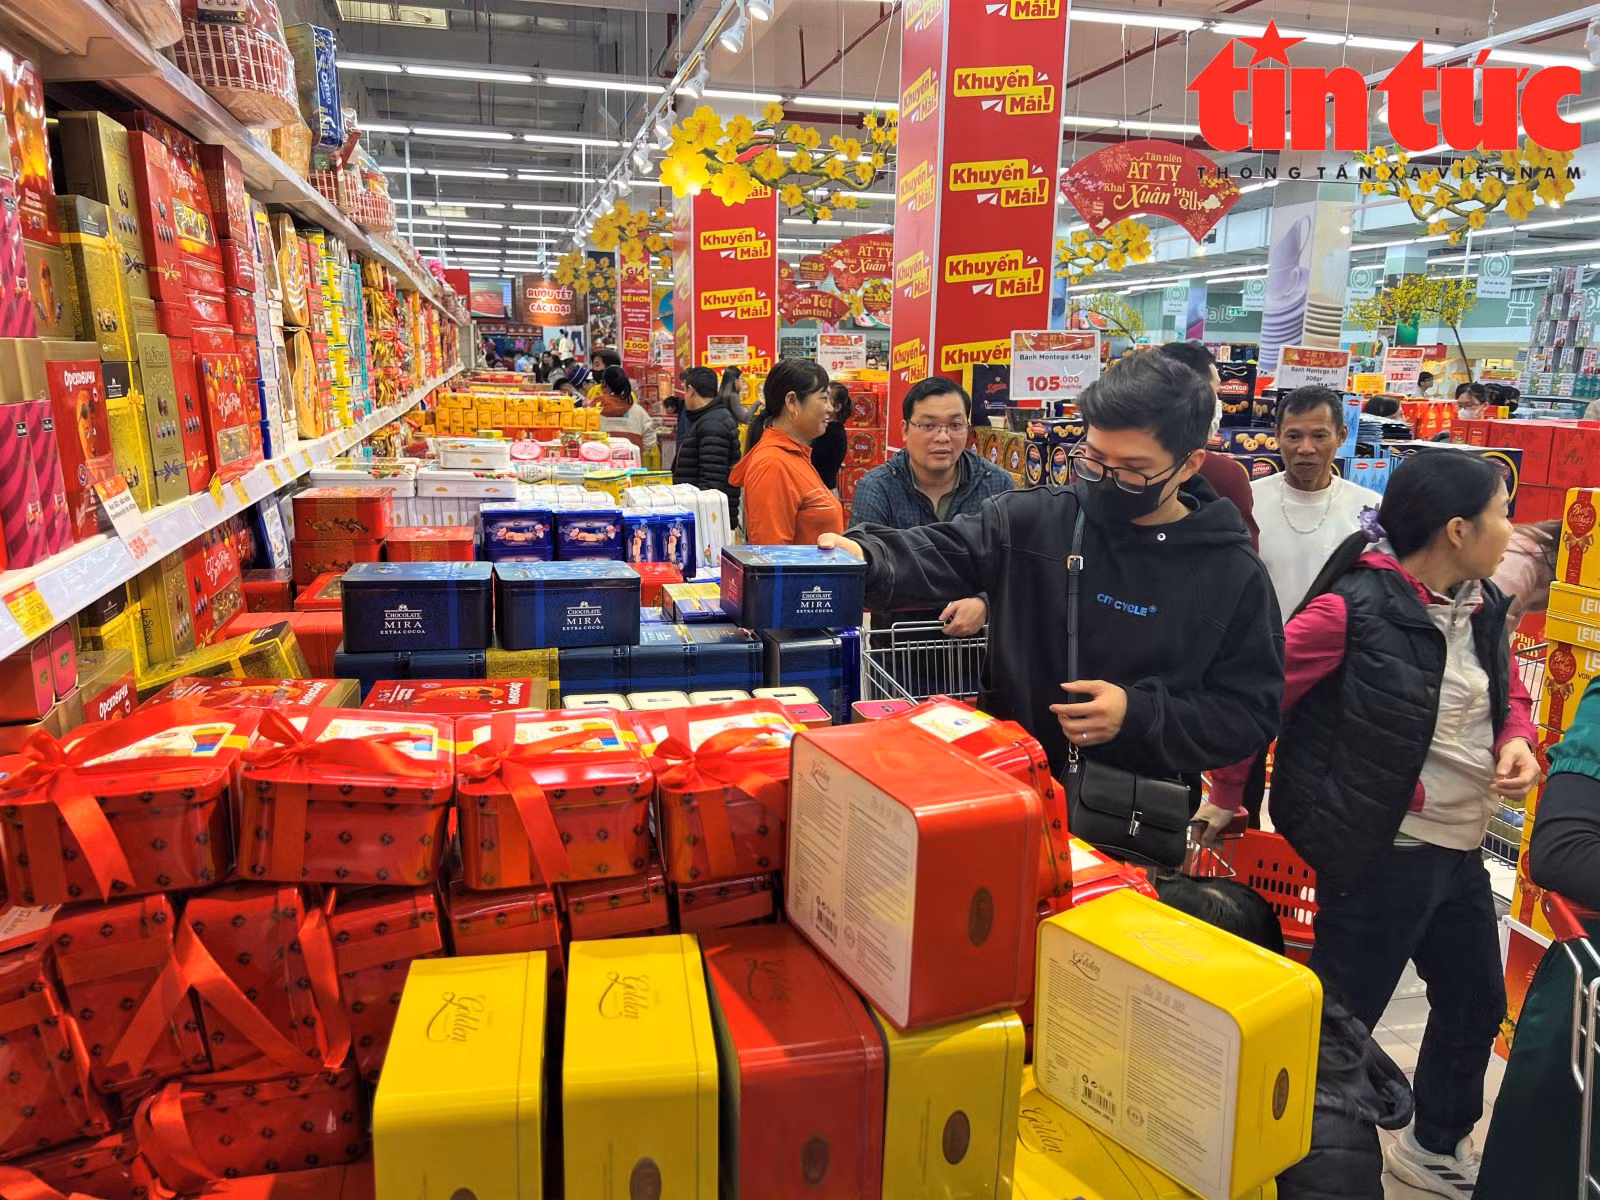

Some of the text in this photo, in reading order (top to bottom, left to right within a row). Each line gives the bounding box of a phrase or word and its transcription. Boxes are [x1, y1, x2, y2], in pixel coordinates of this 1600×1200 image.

[957, 69, 1029, 92] Khuyến
[1010, 87, 1051, 112] Mãi!
[952, 163, 1024, 186] Khuyến
[1004, 180, 1046, 205] Mãi!
[1104, 183, 1125, 192] Khai
[1113, 184, 1171, 210] Xuân
[703, 230, 753, 247] Khuyến
[740, 241, 768, 258] Mãi!
[948, 254, 1018, 277] Khuyến
[1000, 270, 1040, 295] Mãi!
[555, 285, 572, 299] TẾT
[703, 290, 753, 306] Khuyến
[530, 301, 570, 315] CÁC LOẠI
[740, 301, 768, 317] Mãi!
[832, 361, 844, 370] 97
[1019, 353, 1091, 362] Bánh Montego 454gr
[1306, 367, 1330, 375] Montego
[1027, 376, 1060, 392] 105
[1573, 504, 1592, 516] Best
[384, 621, 422, 629] MIRA
[567, 617, 601, 625] MIRA
